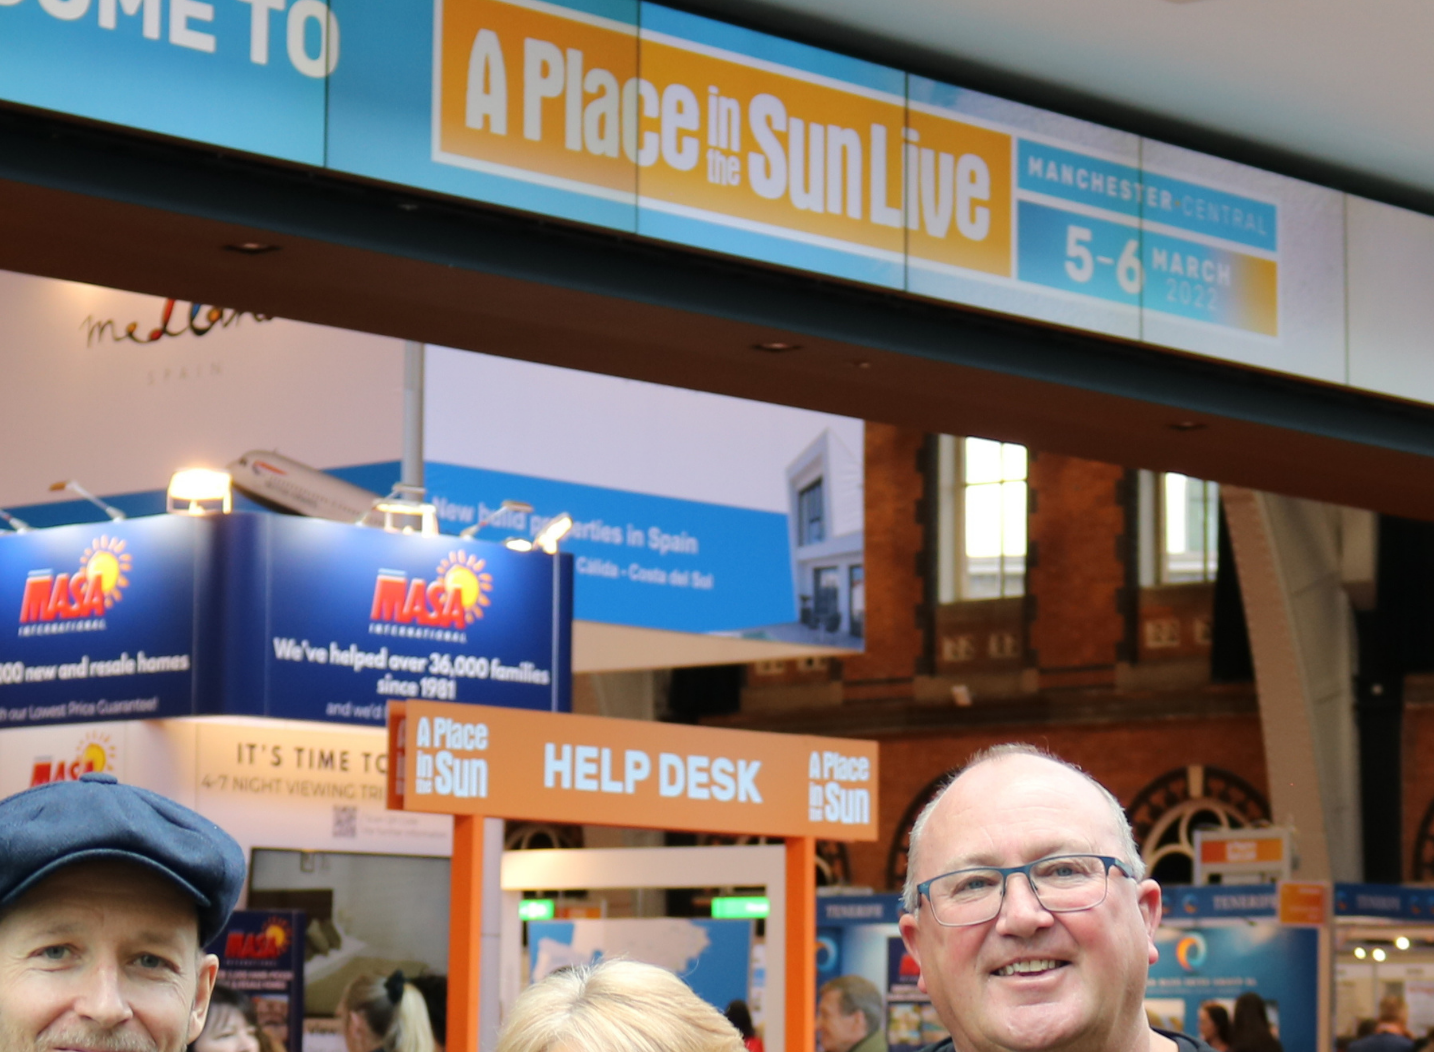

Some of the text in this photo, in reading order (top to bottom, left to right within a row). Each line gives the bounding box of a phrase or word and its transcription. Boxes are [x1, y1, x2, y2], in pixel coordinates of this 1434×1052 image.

[235, 0, 340, 78] TO
[466, 28, 991, 241] A Place in the Sun Live
[1151, 247, 1232, 286] MARCH
[1167, 278, 1218, 312] 2022
[434, 496, 474, 521] New
[627, 524, 644, 546] in
[648, 527, 699, 556] Spain
[628, 563, 666, 584] Costa
[669, 569, 688, 586] del
[692, 572, 715, 590] Sol
[20, 571, 105, 623] MASA
[371, 574, 467, 629] MASA
[18, 619, 107, 637] INTERNATIONAL
[369, 623, 468, 644] INTERNATIONAL
[25, 664, 56, 681] new
[58, 655, 89, 679] and
[90, 652, 135, 676] resale
[137, 651, 189, 671] homes
[273, 637, 550, 685] We've helped over 36,000 families
[377, 673, 456, 699] since 1981
[68, 701, 95, 717] Price
[326, 702, 352, 716] and
[417, 717, 487, 751] A Place
[237, 743, 283, 766] IT'S
[294, 747, 350, 771] TIME
[417, 750, 433, 778] in
[435, 750, 487, 798] Sun
[544, 743, 764, 804] HELP DESK
[809, 751, 870, 782] A Place
[232, 776, 282, 794] NIGHT
[286, 779, 355, 799] VIEWING
[360, 784, 385, 800] TRI
[809, 782, 824, 806] in
[825, 782, 871, 825] Sun
